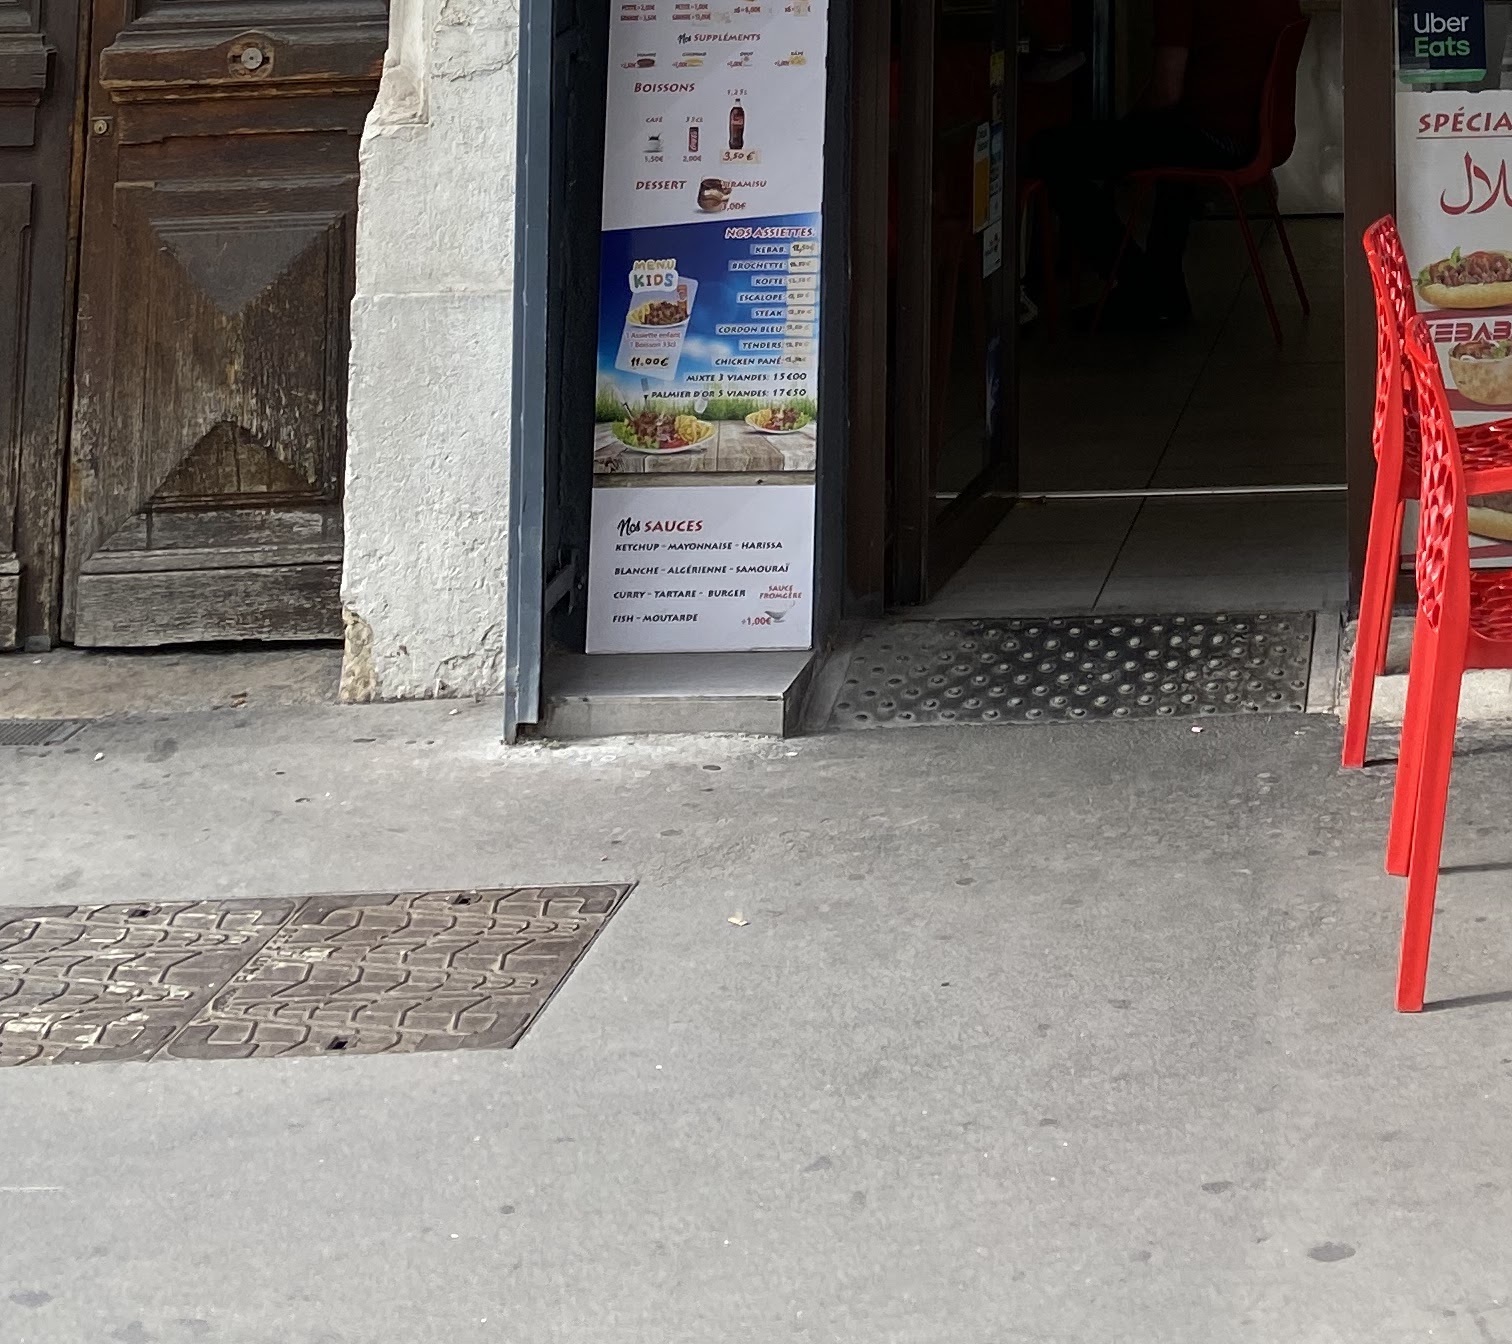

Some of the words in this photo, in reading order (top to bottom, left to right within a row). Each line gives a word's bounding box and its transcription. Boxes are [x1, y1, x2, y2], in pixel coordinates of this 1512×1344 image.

[1413, 12, 1469, 34] Uber
[693, 32, 761, 42] SUPPLÉMENTS
[1413, 36, 1471, 58] Eats
[634, 82, 696, 93] BOISSONS
[635, 180, 688, 190] DESSERT
[726, 227, 752, 239] NOS
[634, 258, 675, 271] MENU
[633, 273, 674, 288] KIDS
[718, 325, 758, 334] CORDON
[1429, 321, 1512, 343] EBAB
[715, 357, 755, 366] CHICKEN
[686, 374, 715, 382] MIXTE
[718, 373, 724, 382] 3
[773, 372, 807, 381] 15€00
[651, 390, 691, 399] PALMIER
[718, 389, 724, 398] 5
[773, 388, 807, 397] 17€50
[617, 516, 641, 537] Nos
[643, 519, 704, 533] SAUCES
[615, 542, 660, 552] KETCHUP
[667, 541, 733, 551] MAYONNAISE
[741, 540, 784, 550] HARISSA
[614, 566, 659, 576] BLANCHE
[666, 564, 727, 574] ALGÉRIENNE
[735, 562, 791, 574] SAMOURAÏ
[768, 584, 794, 592] SAUCE
[613, 590, 646, 599] CURRY
[654, 590, 697, 598] TARTARE
[707, 589, 746, 598] BURGER
[612, 614, 634, 623] FISH
[642, 613, 699, 622] MOUTARDE
